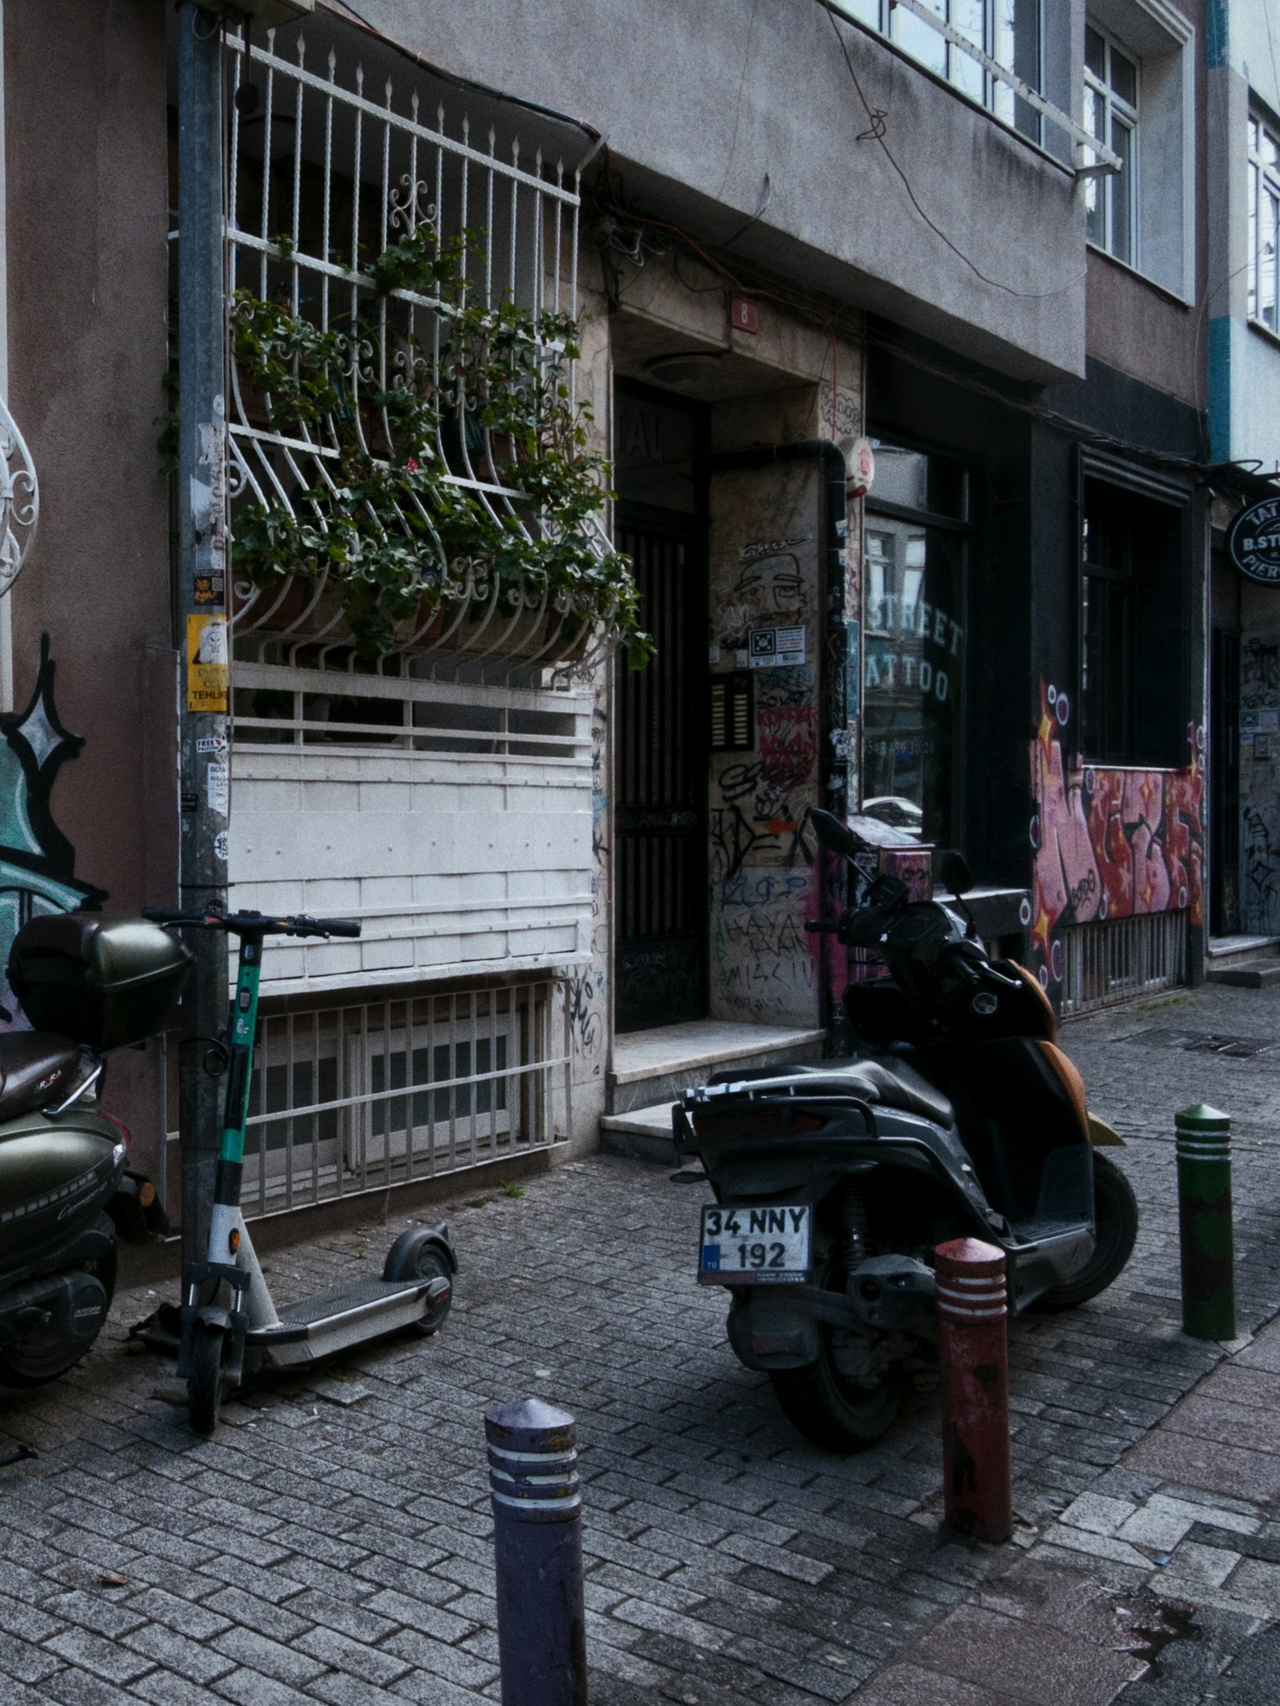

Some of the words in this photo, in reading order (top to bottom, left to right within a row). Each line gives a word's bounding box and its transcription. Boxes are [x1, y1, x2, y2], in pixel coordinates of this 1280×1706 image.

[741, 302, 748, 324] 8
[1242, 553, 1280, 578] PIER
[866, 594, 964, 657] STREET
[197, 739, 215, 747] FREE
[706, 1210, 741, 1236] 34
[749, 1207, 807, 1234] NNY
[707, 1261, 718, 1270] TR
[737, 1242, 785, 1269] 192
